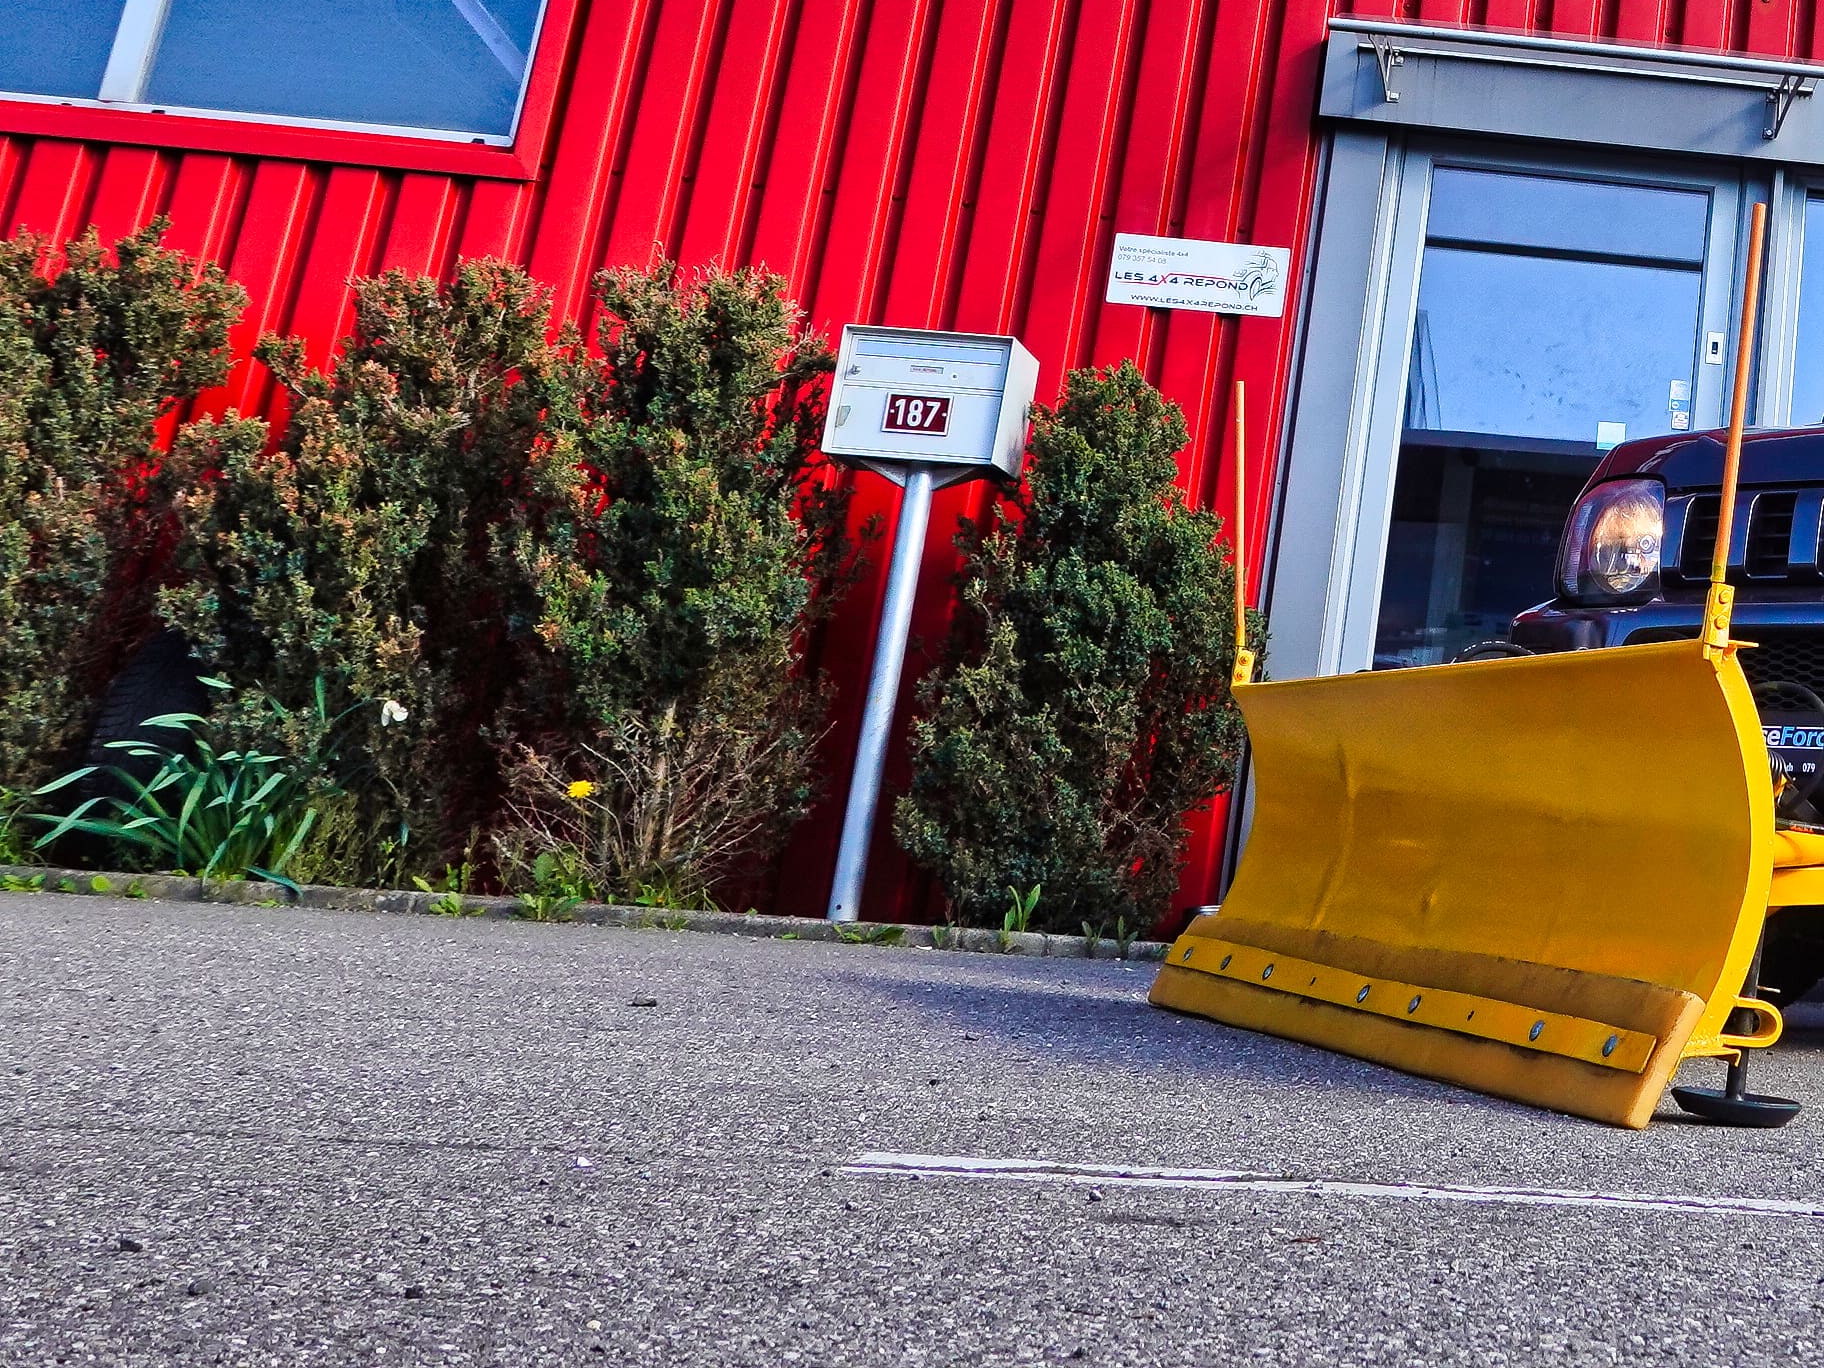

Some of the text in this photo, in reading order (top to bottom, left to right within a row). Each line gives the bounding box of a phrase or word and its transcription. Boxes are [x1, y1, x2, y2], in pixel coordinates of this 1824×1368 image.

[1117, 253, 1131, 261] 079
[1115, 271, 1144, 282] LES
[1183, 277, 1249, 292] REPOND
[895, 398, 942, 428] 187
